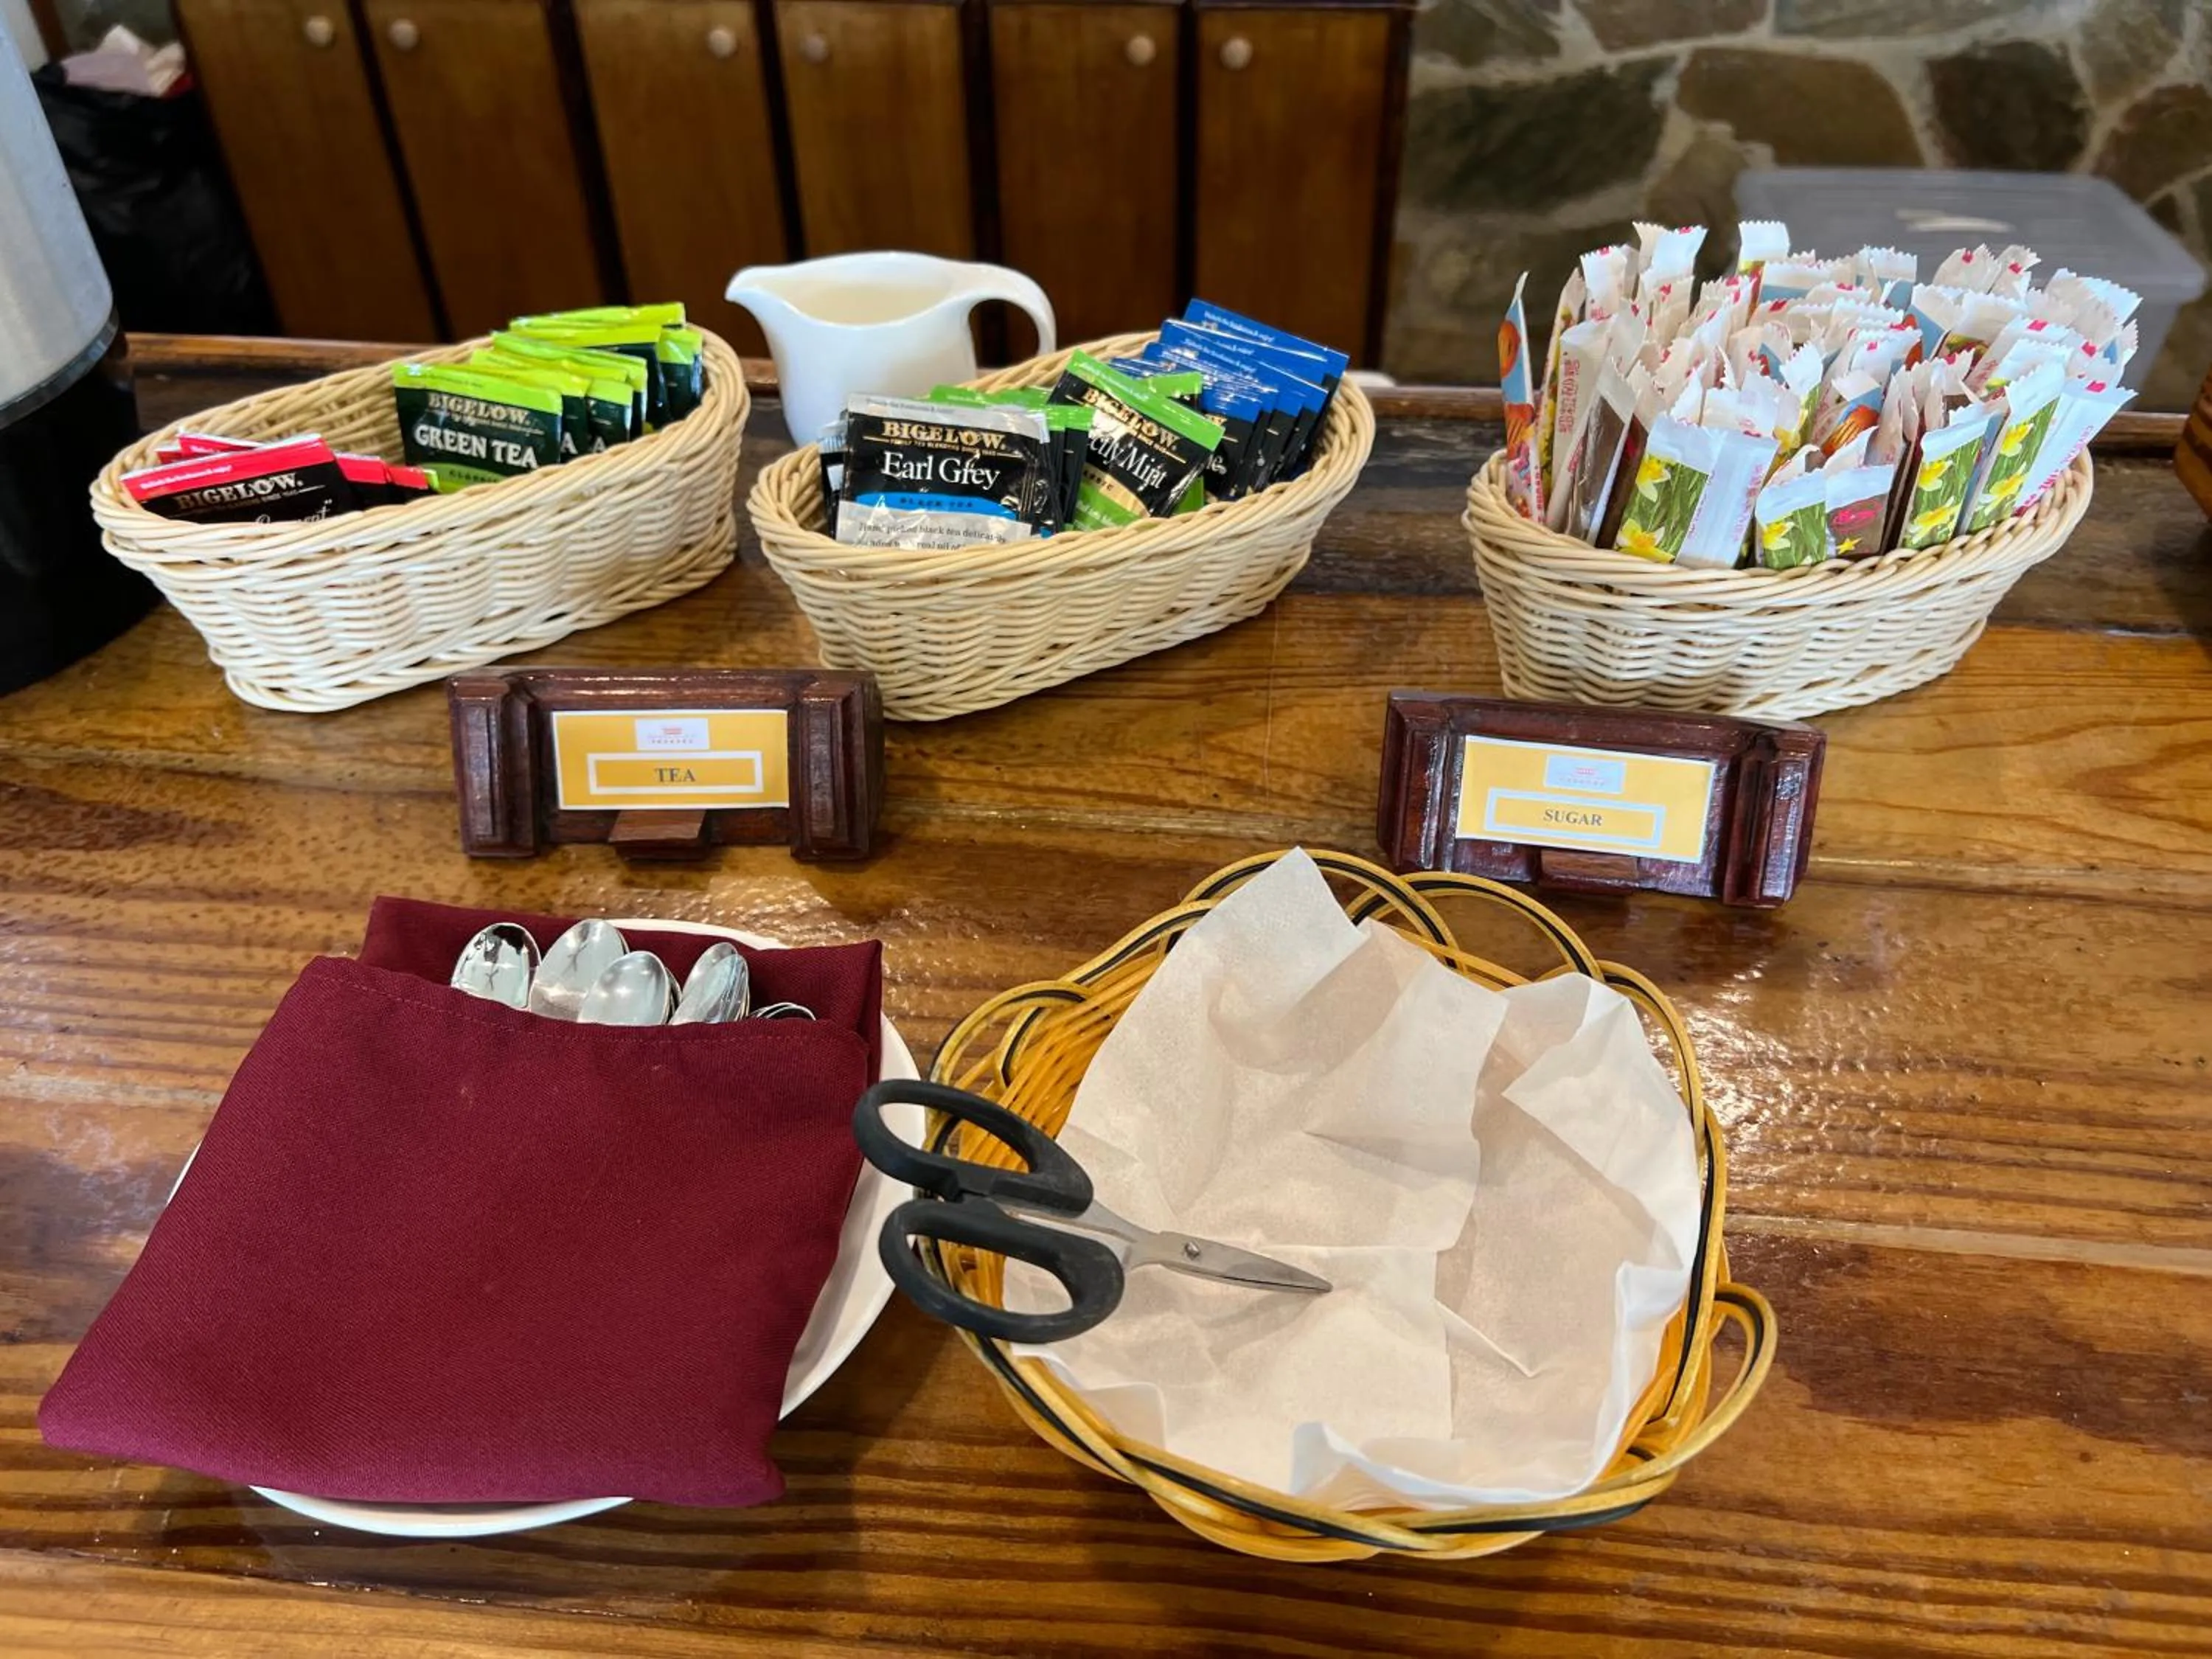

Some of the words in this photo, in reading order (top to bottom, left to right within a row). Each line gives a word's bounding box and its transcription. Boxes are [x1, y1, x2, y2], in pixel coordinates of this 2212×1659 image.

[414, 424, 487, 459] GREEN
[491, 440, 538, 469] TEA
[880, 450, 934, 481] Earl
[938, 454, 1001, 491] Grey
[655, 768, 696, 783] TEA
[1543, 807, 1603, 827] SUGAR
